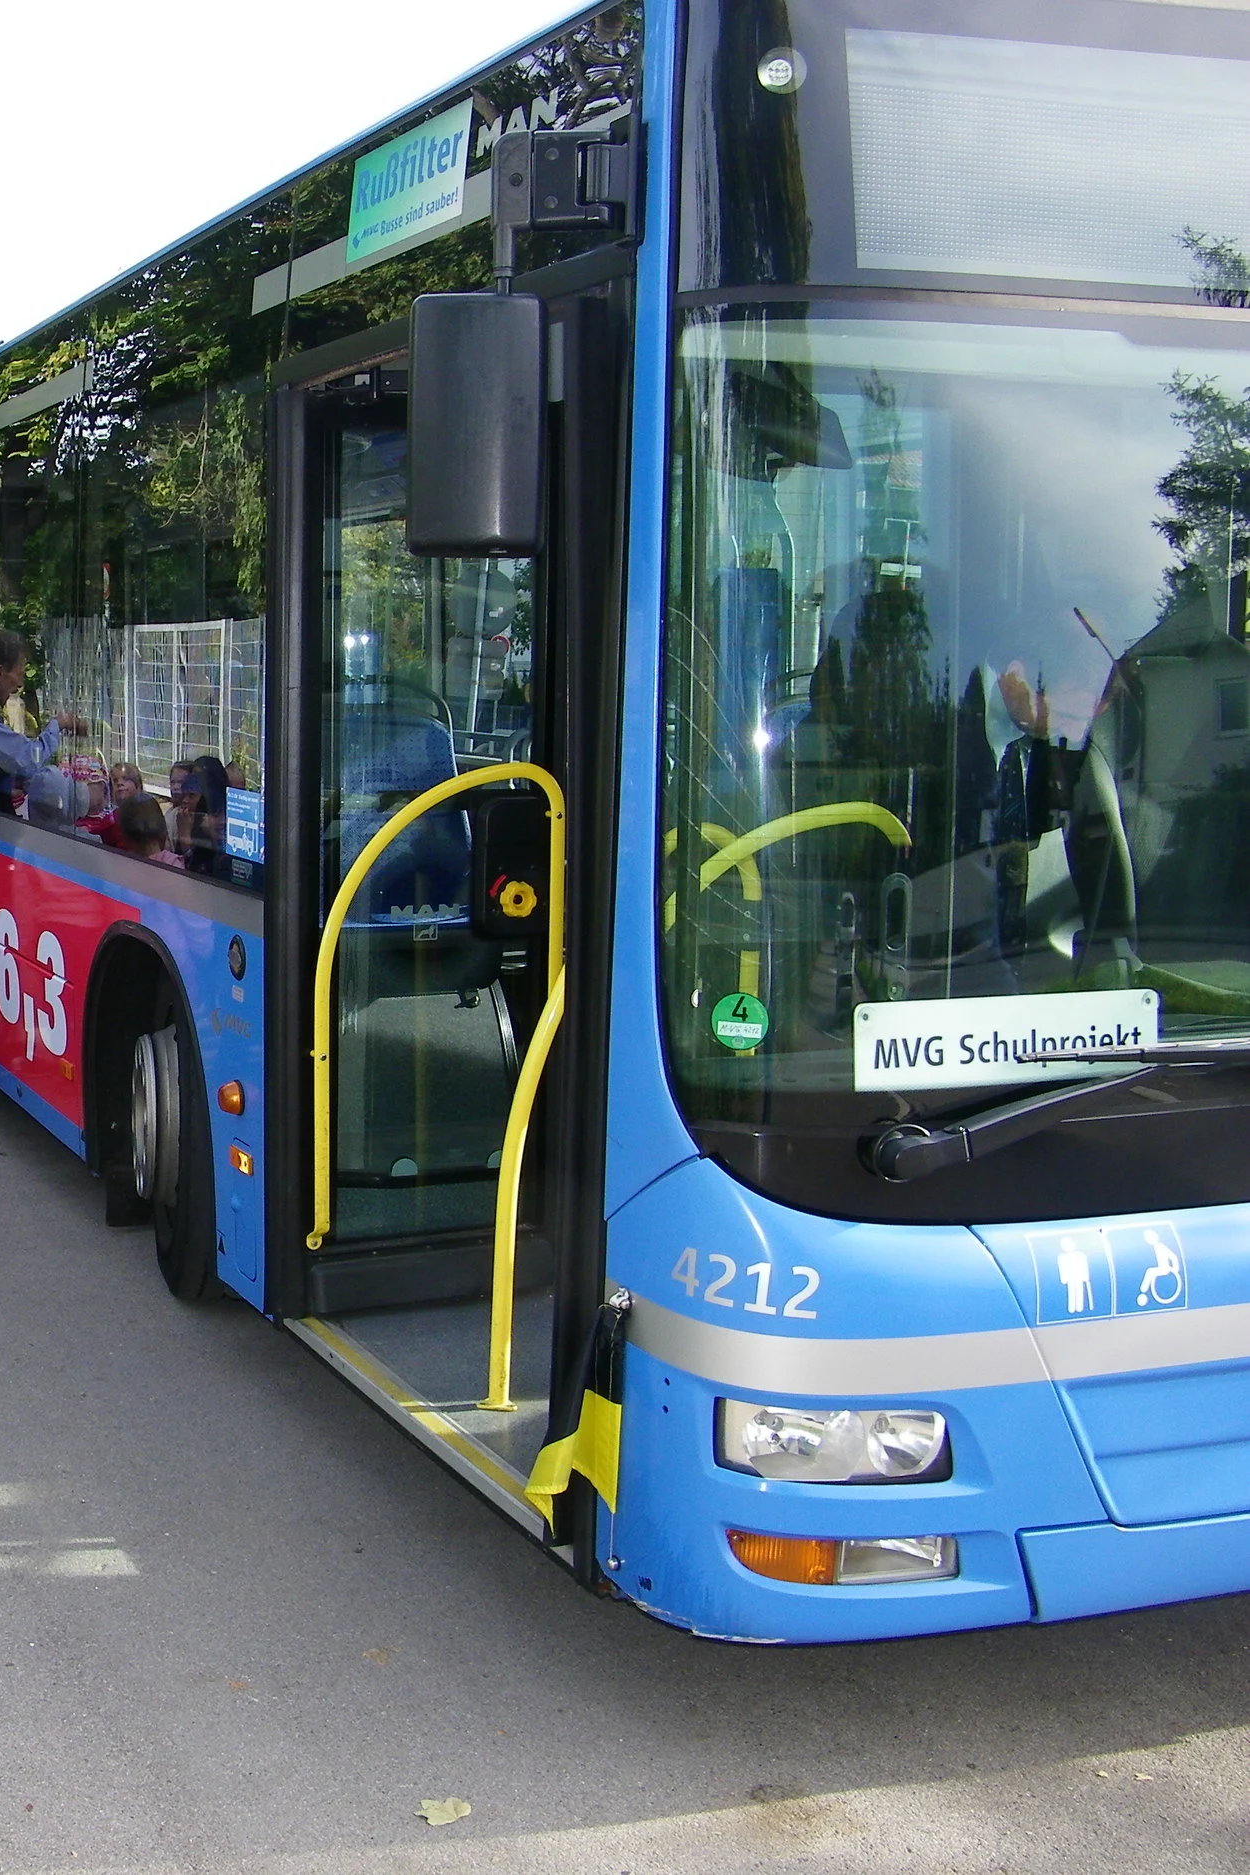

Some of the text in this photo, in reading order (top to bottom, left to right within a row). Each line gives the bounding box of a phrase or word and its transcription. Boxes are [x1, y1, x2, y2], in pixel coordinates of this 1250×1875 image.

[476, 86, 559, 159] MAN
[355, 129, 464, 214] Rußfilter
[361, 186, 459, 240] MVG Busse sind sauber!
[390, 903, 460, 921] MAN
[731, 995, 749, 1022] 4
[873, 1035, 944, 1070] MVG
[671, 1245, 820, 1320] 4212
